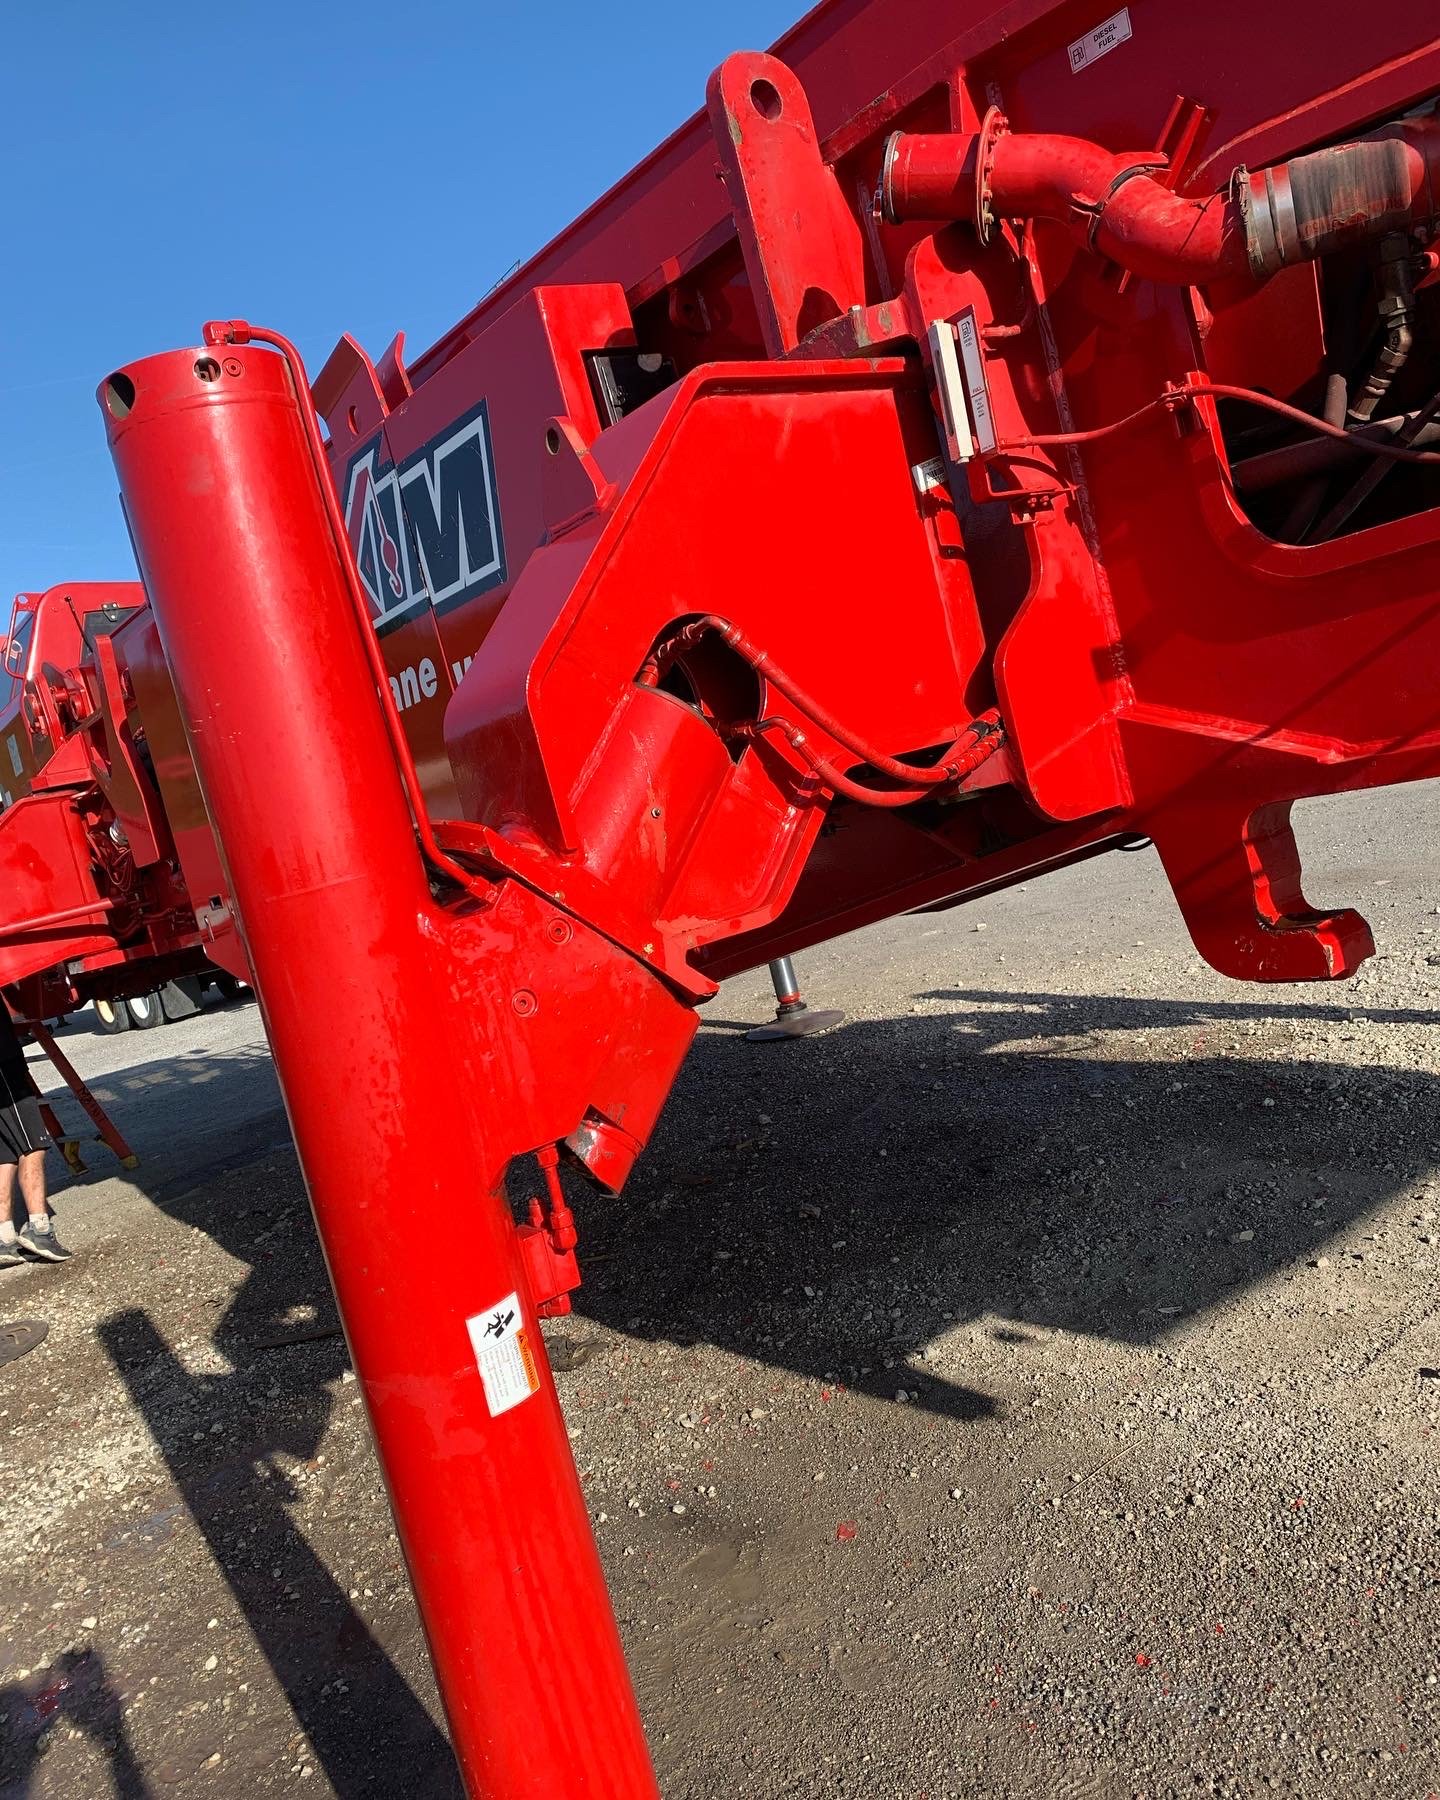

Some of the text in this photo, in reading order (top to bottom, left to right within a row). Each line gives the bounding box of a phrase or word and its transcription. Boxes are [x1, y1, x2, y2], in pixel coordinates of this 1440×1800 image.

[1093, 23, 1117, 42] DIESEL
[1098, 34, 1116, 49] FUEL
[522, 1343, 536, 1386] WARNING
